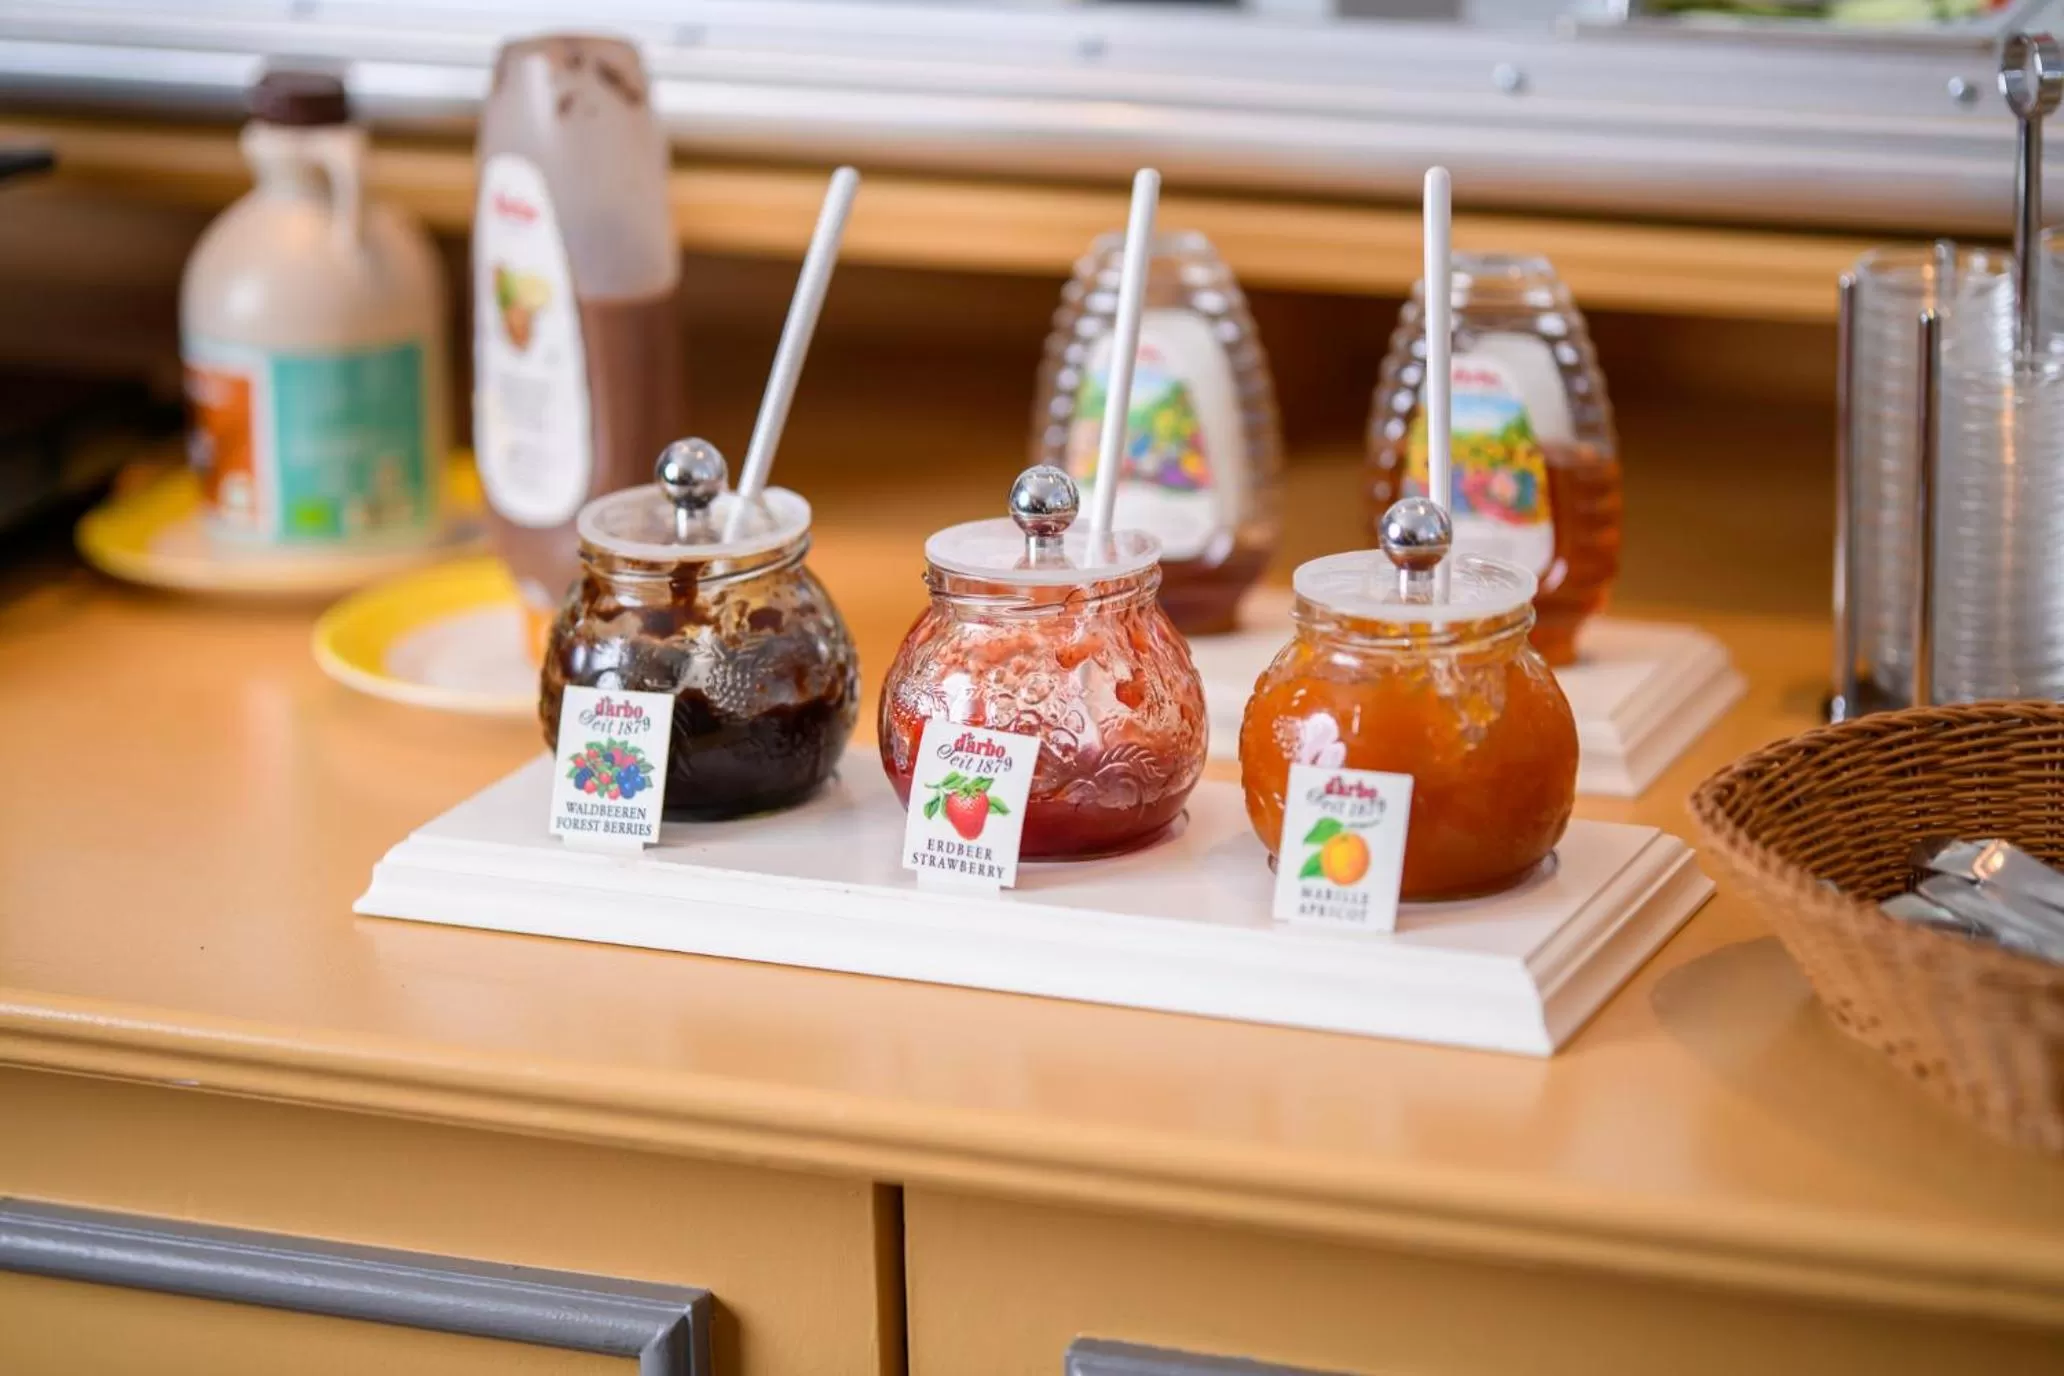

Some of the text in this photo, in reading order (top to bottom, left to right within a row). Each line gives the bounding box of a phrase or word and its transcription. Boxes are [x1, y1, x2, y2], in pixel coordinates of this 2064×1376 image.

[578, 709, 651, 736] Seit 1879
[936, 743, 1013, 774] Seit 1879
[565, 801, 647, 820] WALDBEEREN
[555, 816, 653, 837] FOREST BERRIES
[927, 838, 993, 861] ERDBEER
[911, 852, 1007, 879] STRAWBERRY
